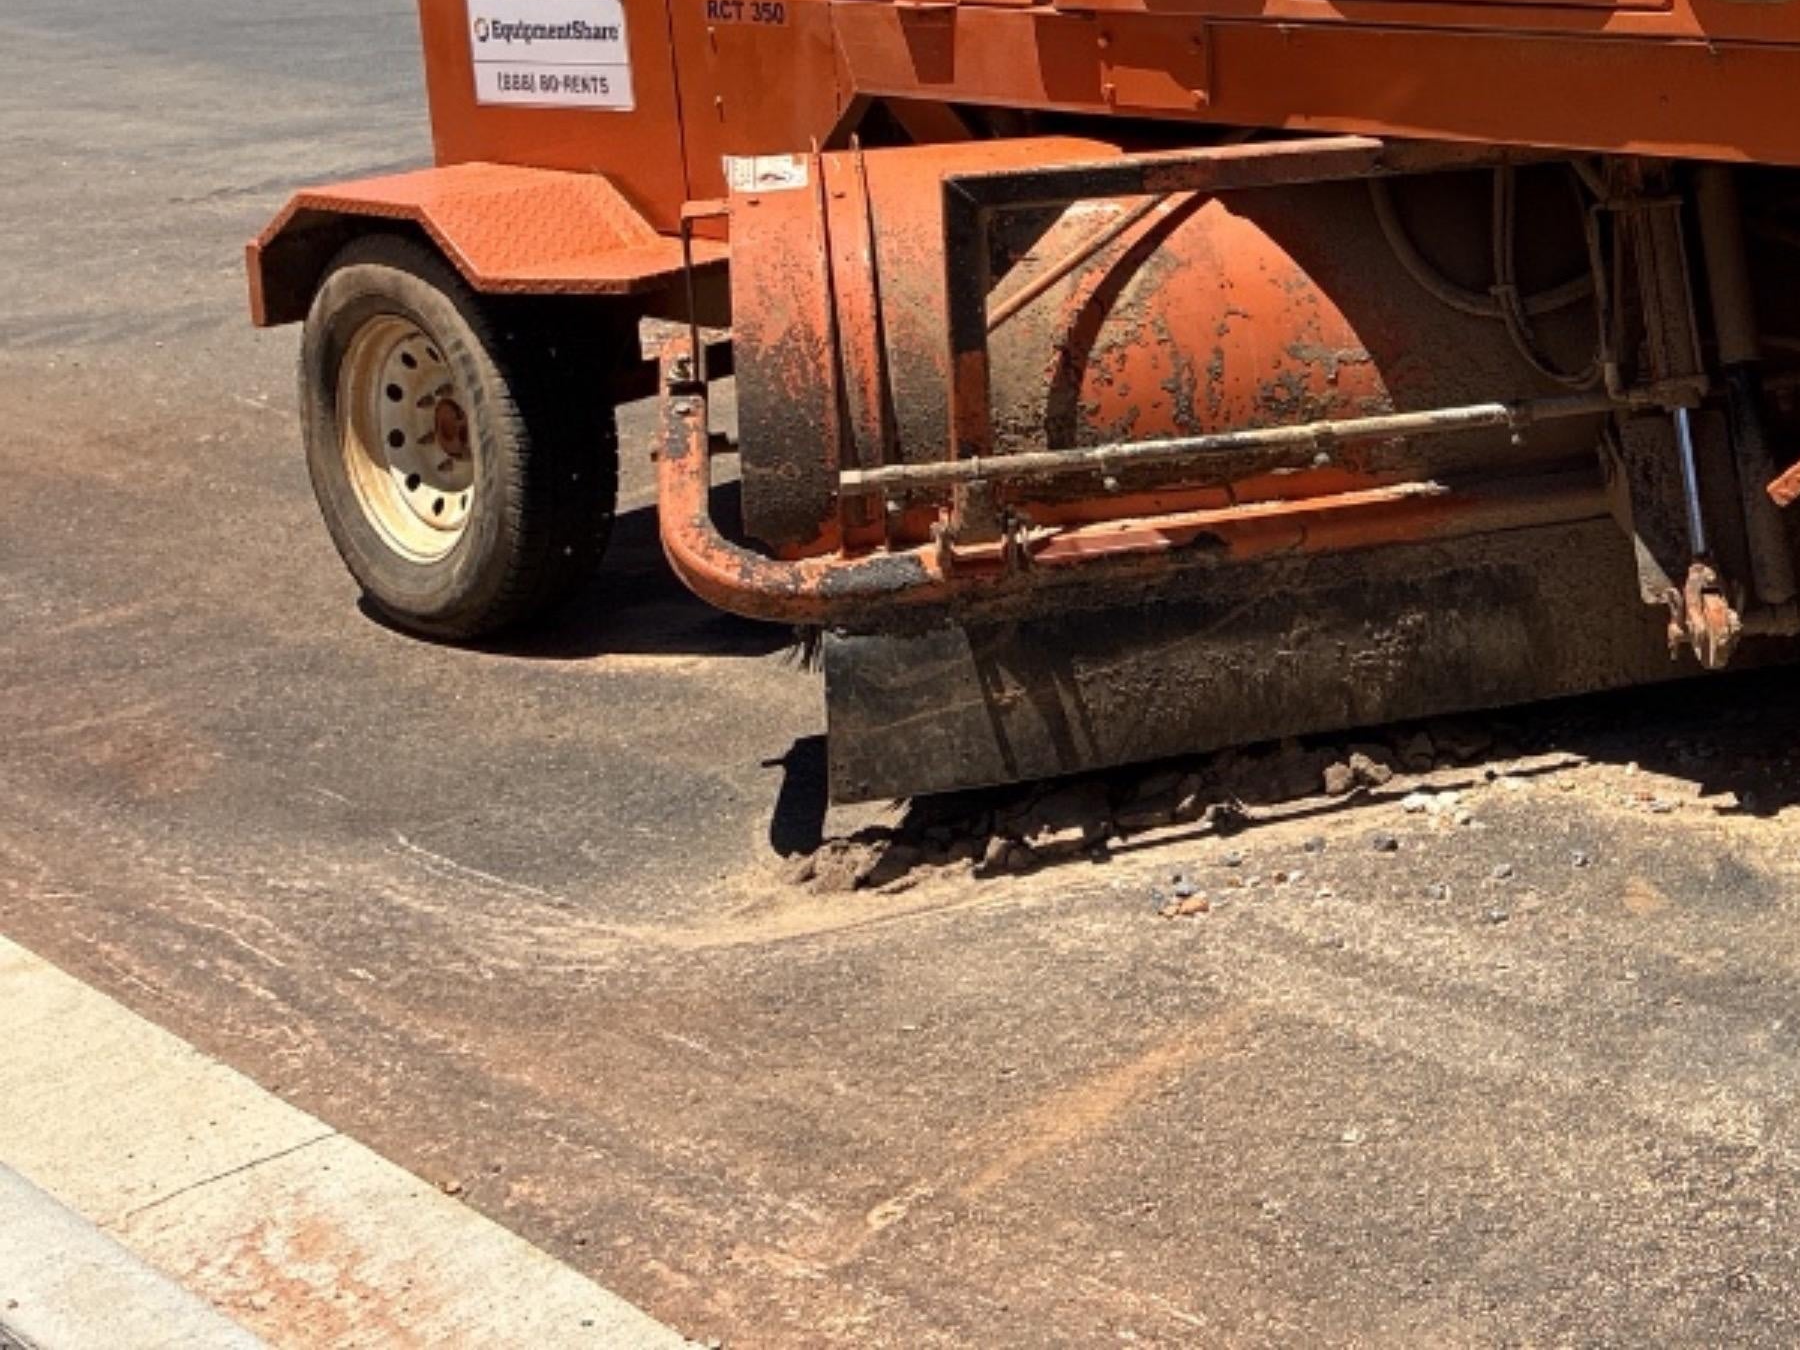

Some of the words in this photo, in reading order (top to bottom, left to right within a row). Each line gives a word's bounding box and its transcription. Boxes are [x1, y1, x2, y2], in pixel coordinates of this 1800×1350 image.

[706, 0, 744, 21] RCT
[751, 1, 786, 25] 350
[491, 20, 619, 45] EquipmentShare
[497, 71, 537, 93] (888)
[540, 74, 610, 96] 80-RENTS
